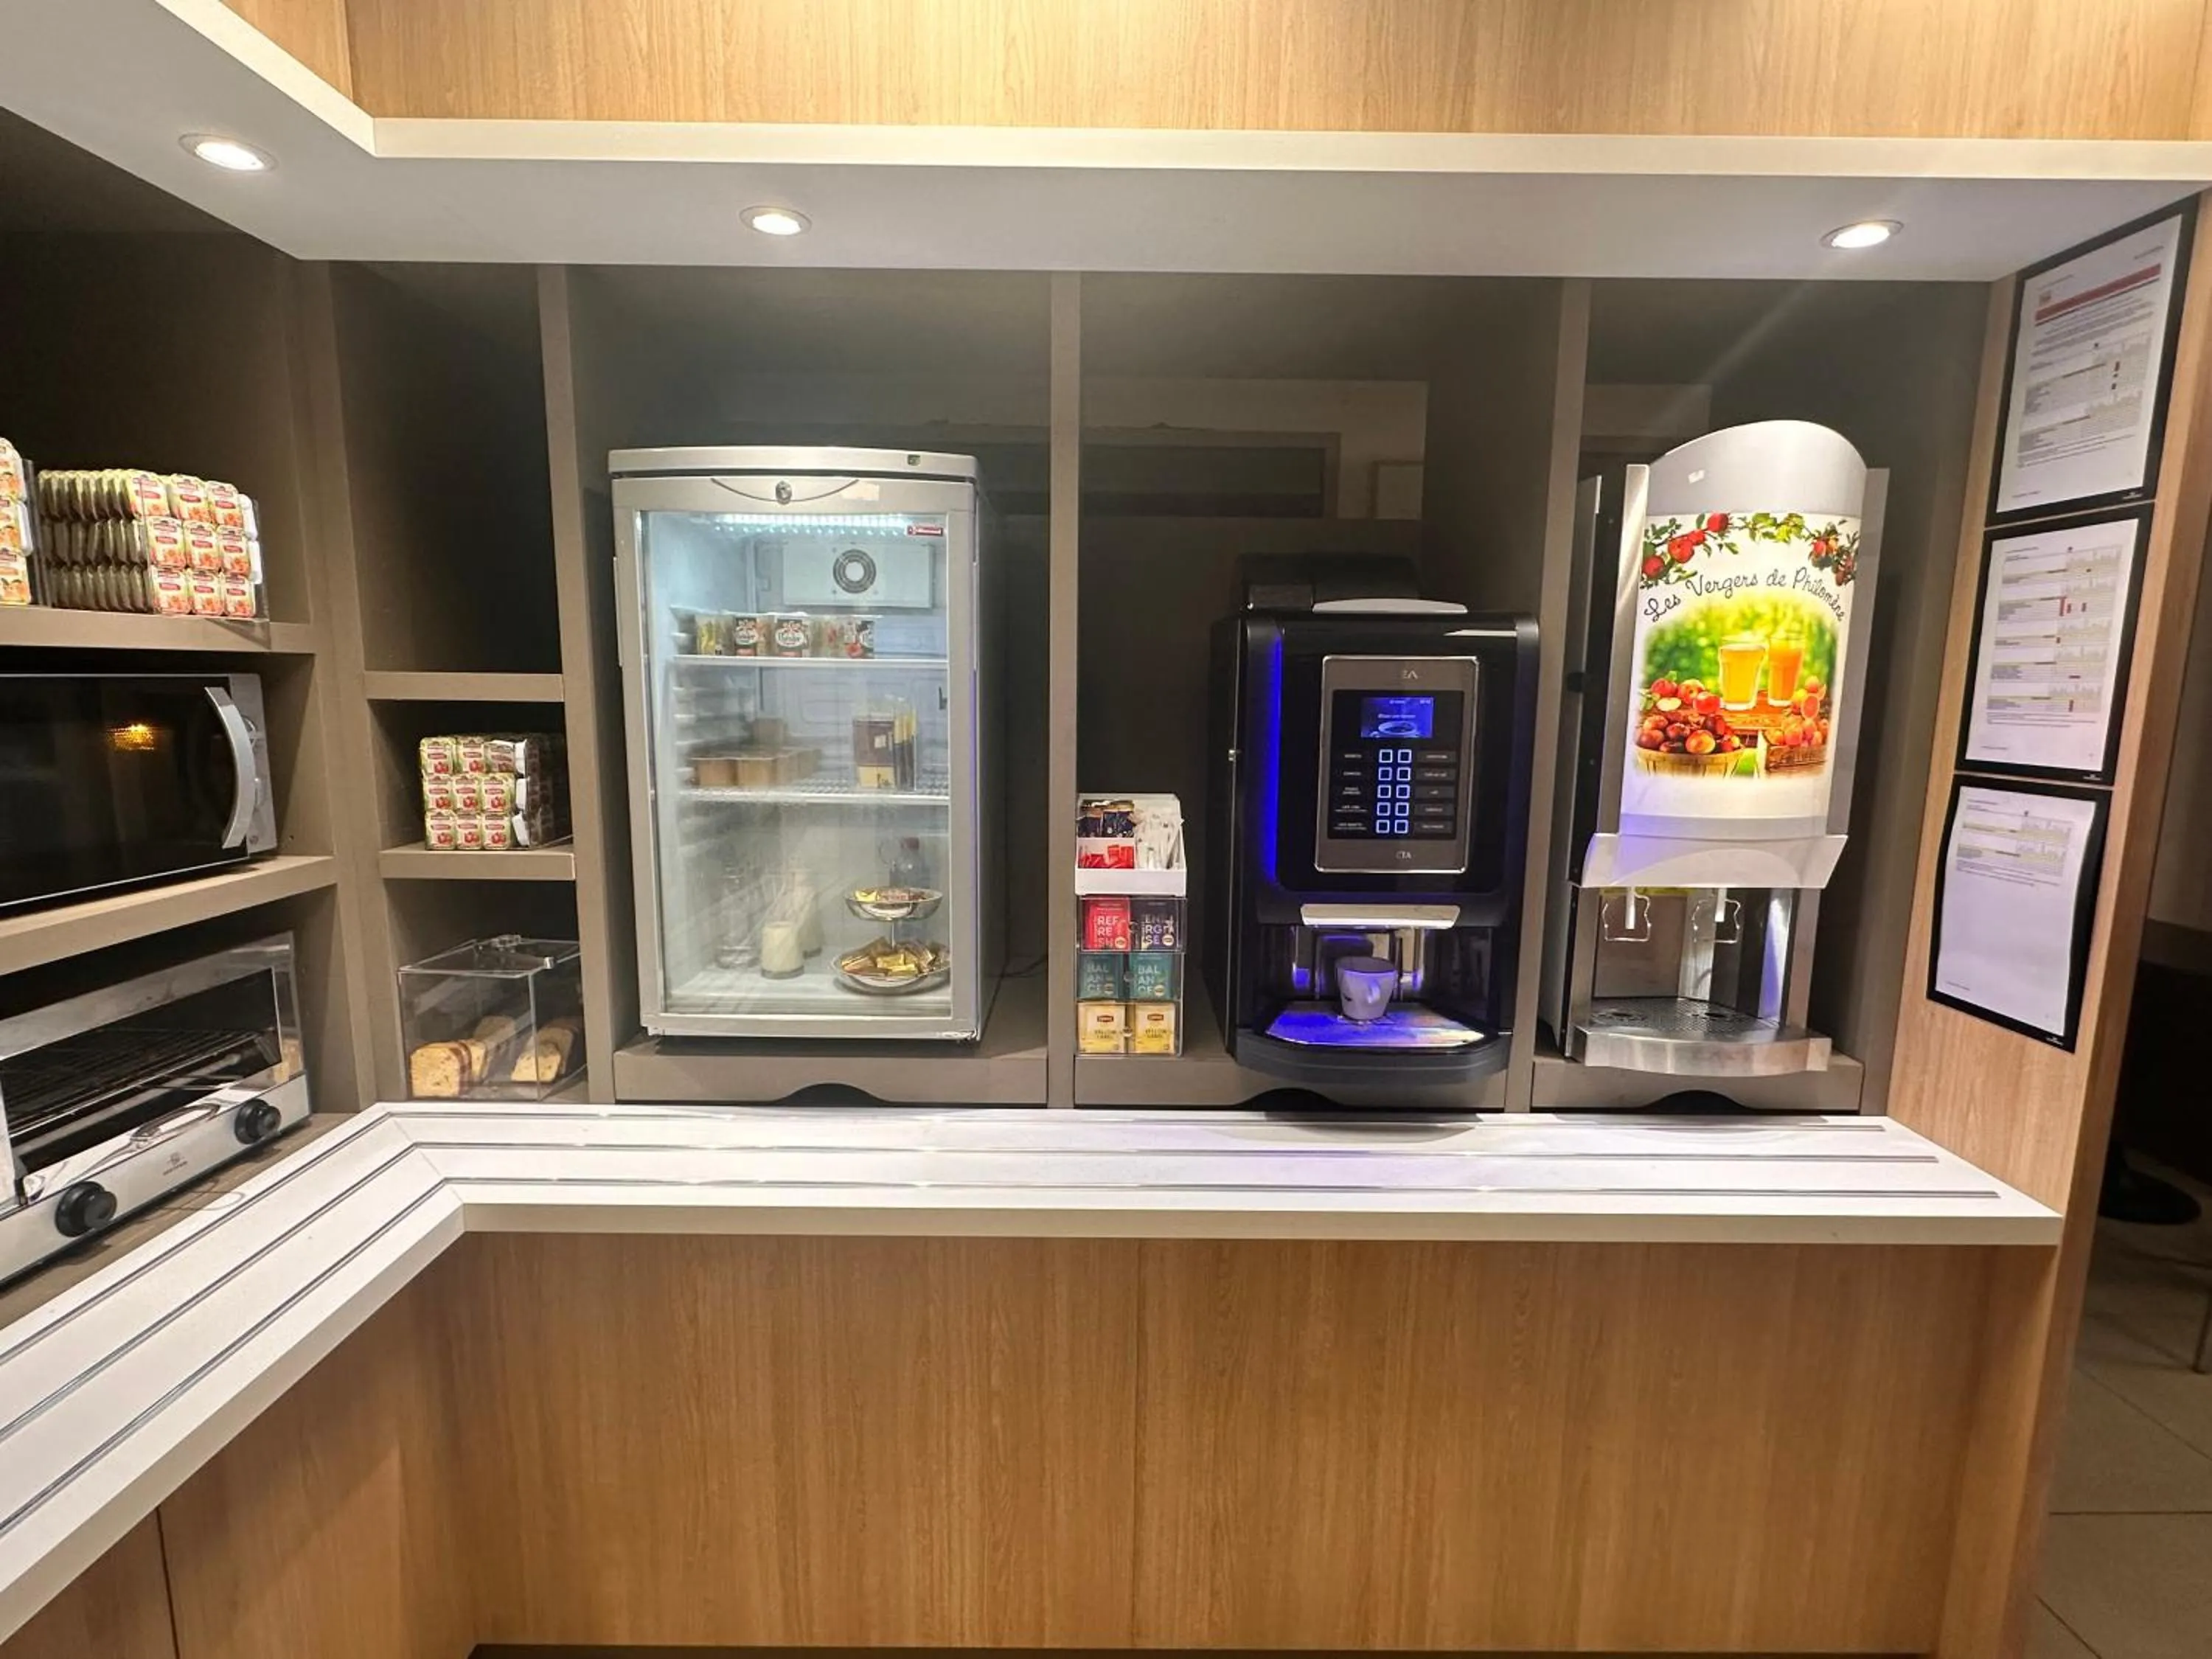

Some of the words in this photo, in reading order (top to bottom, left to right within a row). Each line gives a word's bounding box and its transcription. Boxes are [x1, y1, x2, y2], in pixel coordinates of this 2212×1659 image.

[1644, 594, 1681, 622] Les
[1685, 573, 1759, 599] Vergers
[1766, 568, 1787, 587] de
[1097, 915, 1119, 925] REF
[1097, 926, 1113, 936] RE
[1138, 964, 1160, 974] BAL
[1138, 975, 1155, 984] AN
